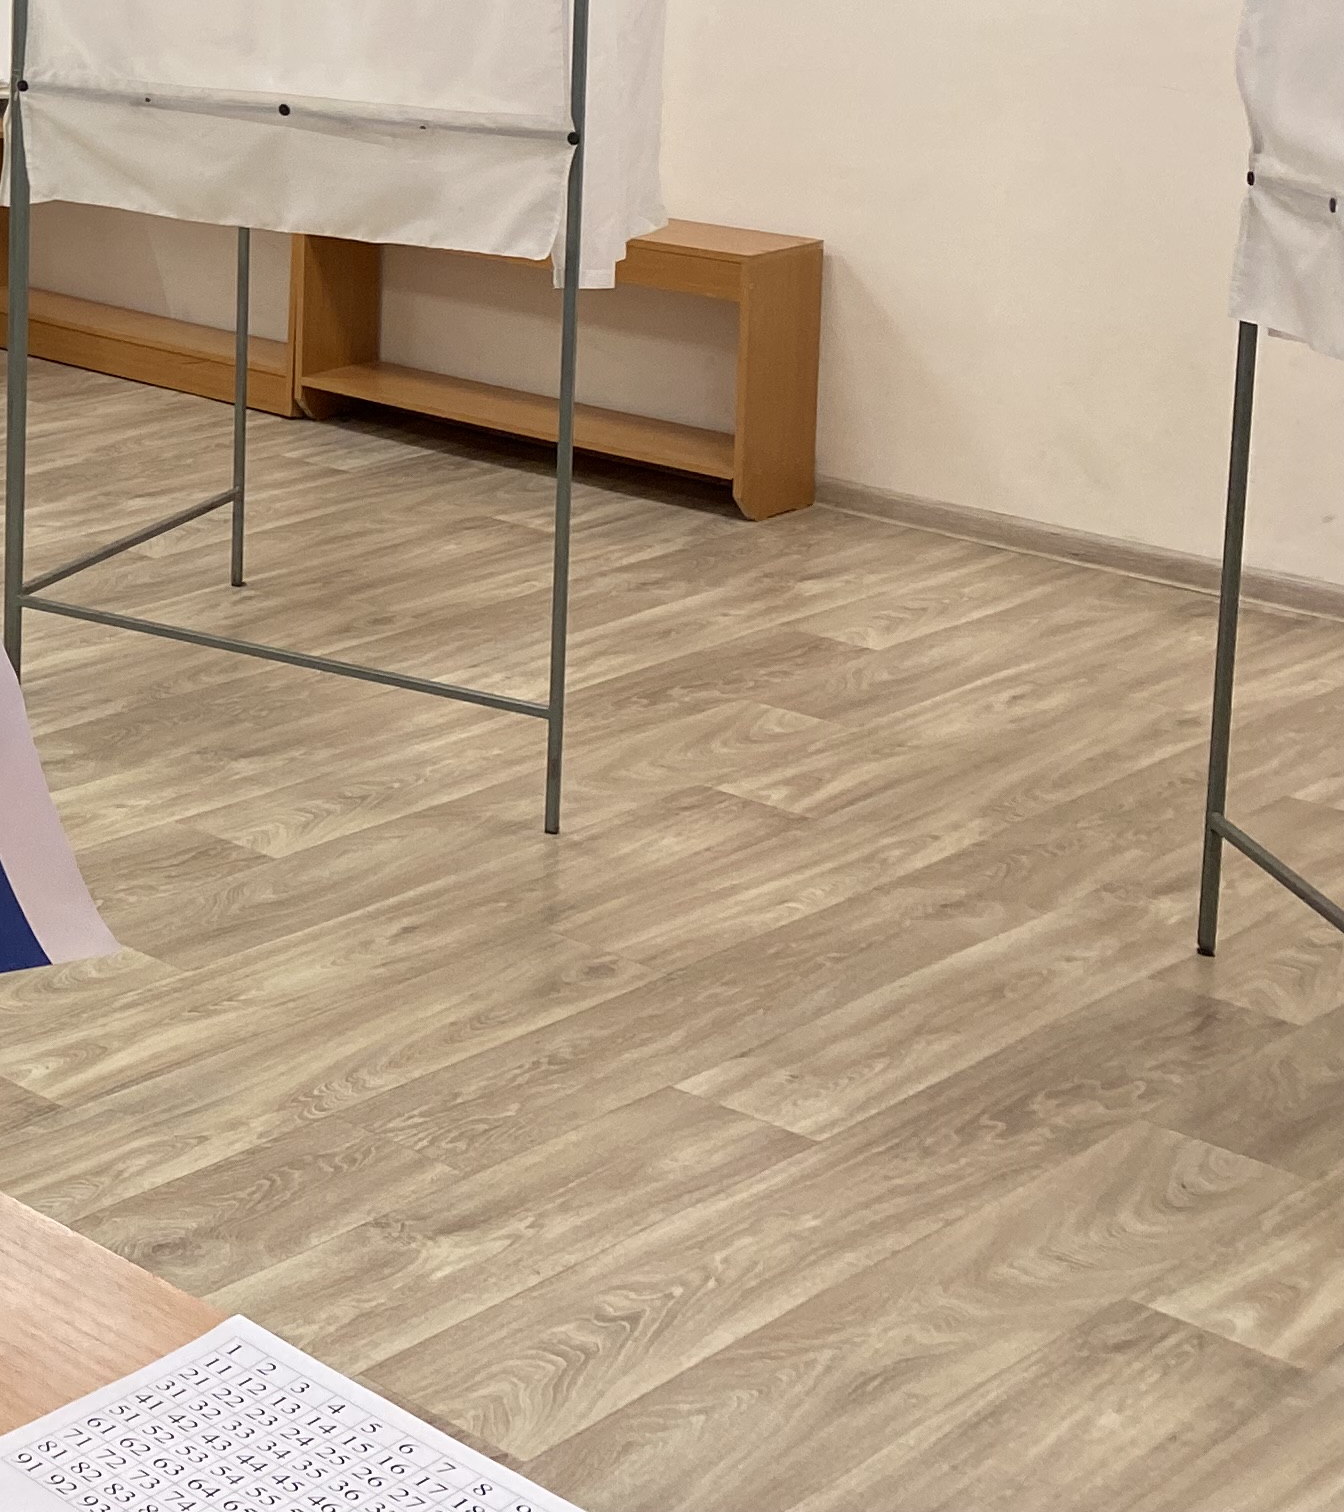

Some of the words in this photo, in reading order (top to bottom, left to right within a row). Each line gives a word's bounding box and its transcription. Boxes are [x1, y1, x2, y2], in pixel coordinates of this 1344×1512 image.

[17, 1452, 44, 1473] 91
[50, 1474, 78, 1495] 92
[37, 1440, 68, 1460] 81
[70, 1461, 103, 1483] 82
[103, 1482, 137, 1503] 83
[62, 1427, 94, 1449] 71
[95, 1447, 128, 1471] 72
[128, 1468, 162, 1491] 73
[162, 1489, 198, 1512] 74
[86, 1417, 117, 1435] 61
[119, 1437, 152, 1457] 62
[152, 1457, 185, 1476] 63
[187, 1478, 222, 1499] 64
[108, 1405, 141, 1423] 51
[141, 1425, 175, 1444] 52
[174, 1445, 209, 1463] 53
[209, 1466, 245, 1485] 54
[245, 1487, 282, 1506] 55
[135, 1394, 164, 1411] 41
[167, 1414, 199, 1433] 42
[201, 1435, 233, 1451] 43
[235, 1455, 269, 1473] 44
[271, 1475, 306, 1492] 45
[307, 1496, 341, 1512] 46
[155, 1380, 187, 1399] 31
[188, 1400, 222, 1420] 32
[221, 1420, 256, 1439] 33
[256, 1440, 292, 1460] 34
[292, 1459, 329, 1479] 35
[328, 1480, 366, 1501] 36
[178, 1368, 210, 1386] 21
[211, 1387, 245, 1408] 22
[245, 1408, 279, 1427] 23
[279, 1427, 315, 1447] 24
[315, 1446, 351, 1465] 25
[351, 1467, 389, 1488] 26
[387, 1488, 427, 1508] 27
[205, 1357, 233, 1375] 11
[237, 1377, 267, 1396] 12
[271, 1396, 302, 1415] 13
[306, 1416, 338, 1435] 14
[341, 1435, 375, 1453] 15
[378, 1455, 412, 1475] 16
[415, 1476, 449, 1494] 17
[227, 1344, 243, 1356] 1
[256, 1362, 277, 1376] 2
[290, 1382, 311, 1394] 3
[327, 1404, 347, 1415] 4
[360, 1422, 384, 1435] 5
[397, 1442, 421, 1456] 6
[435, 1461, 458, 1474] 7
[472, 1483, 493, 1497] 8
